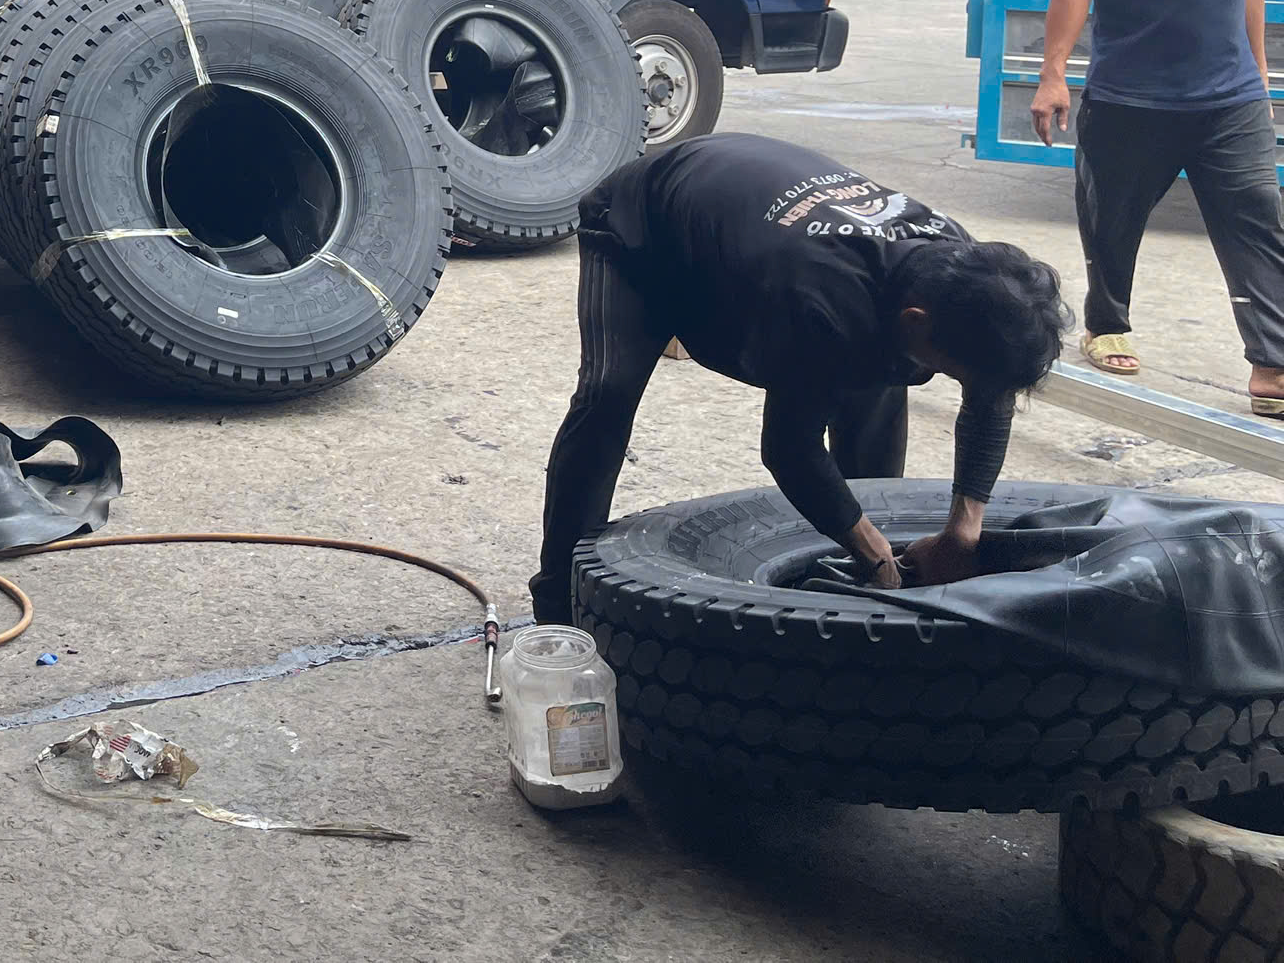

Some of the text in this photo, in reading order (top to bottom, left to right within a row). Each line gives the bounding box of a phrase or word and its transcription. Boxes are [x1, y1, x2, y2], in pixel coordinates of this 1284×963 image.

[763, 173, 845, 221] 0973 770 722
[826, 181, 881, 200] LONG
